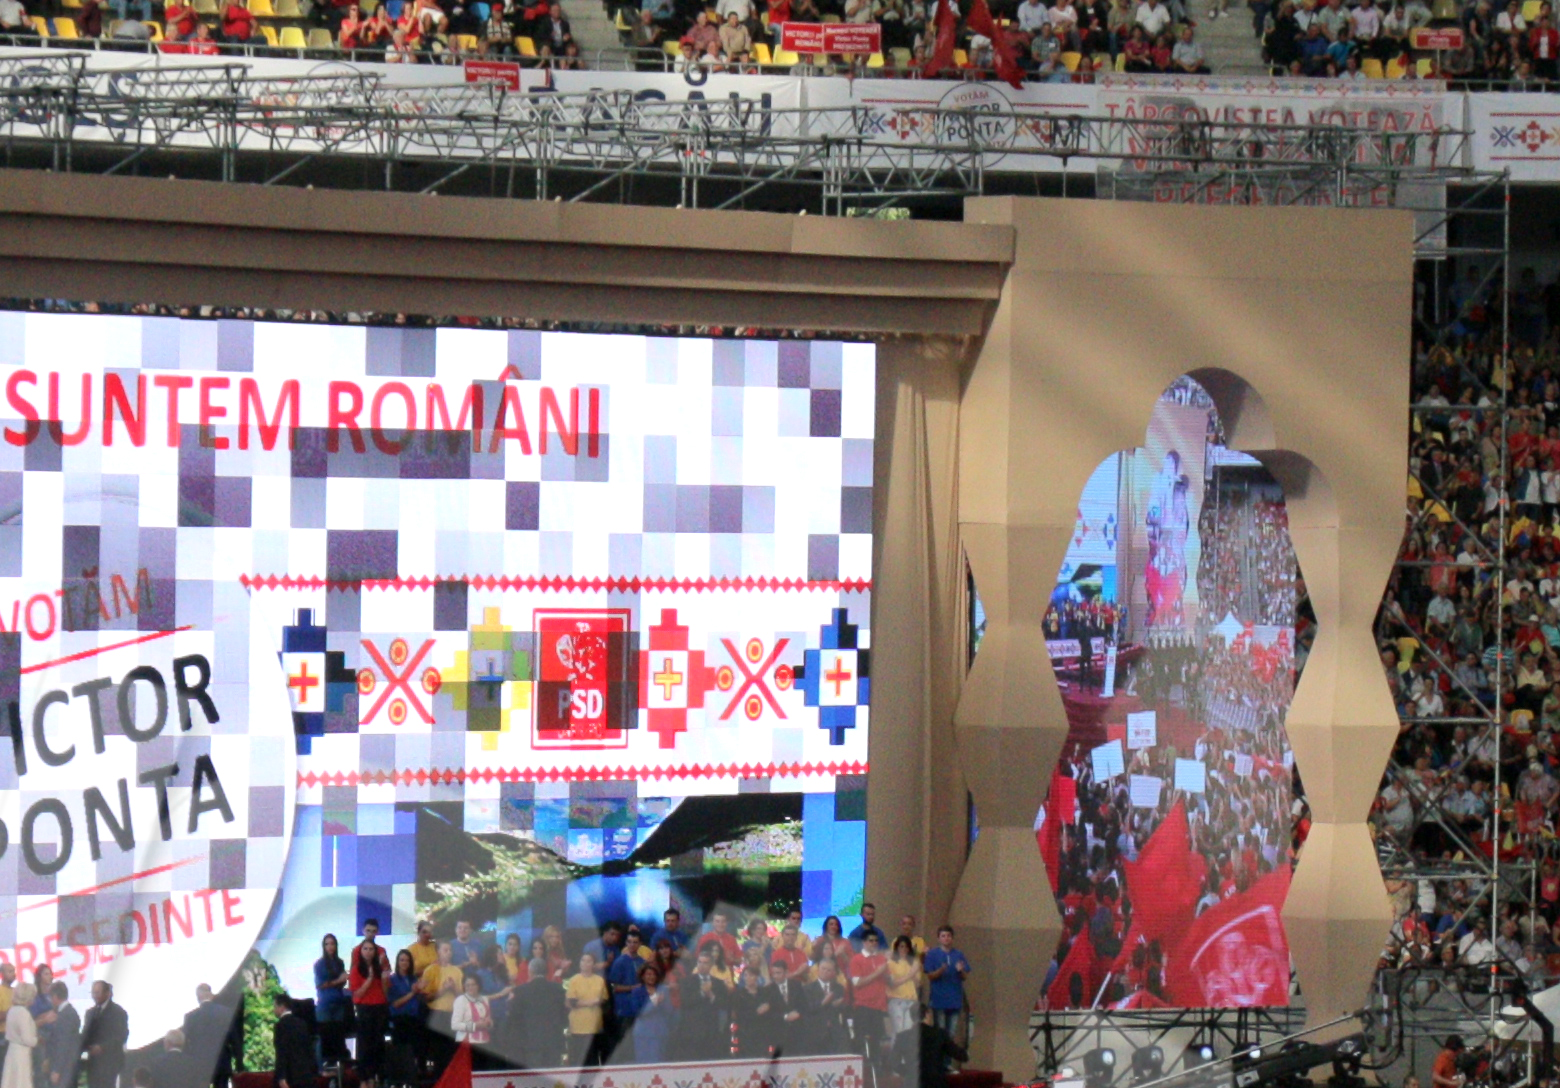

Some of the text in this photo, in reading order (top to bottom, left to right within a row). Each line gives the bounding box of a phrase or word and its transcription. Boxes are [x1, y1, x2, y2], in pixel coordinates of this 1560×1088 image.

[947, 120, 1005, 141] PONTA
[3, 369, 300, 451] SUNTEM
[326, 363, 600, 459] ROMÂNI
[557, 689, 603, 719] PSD
